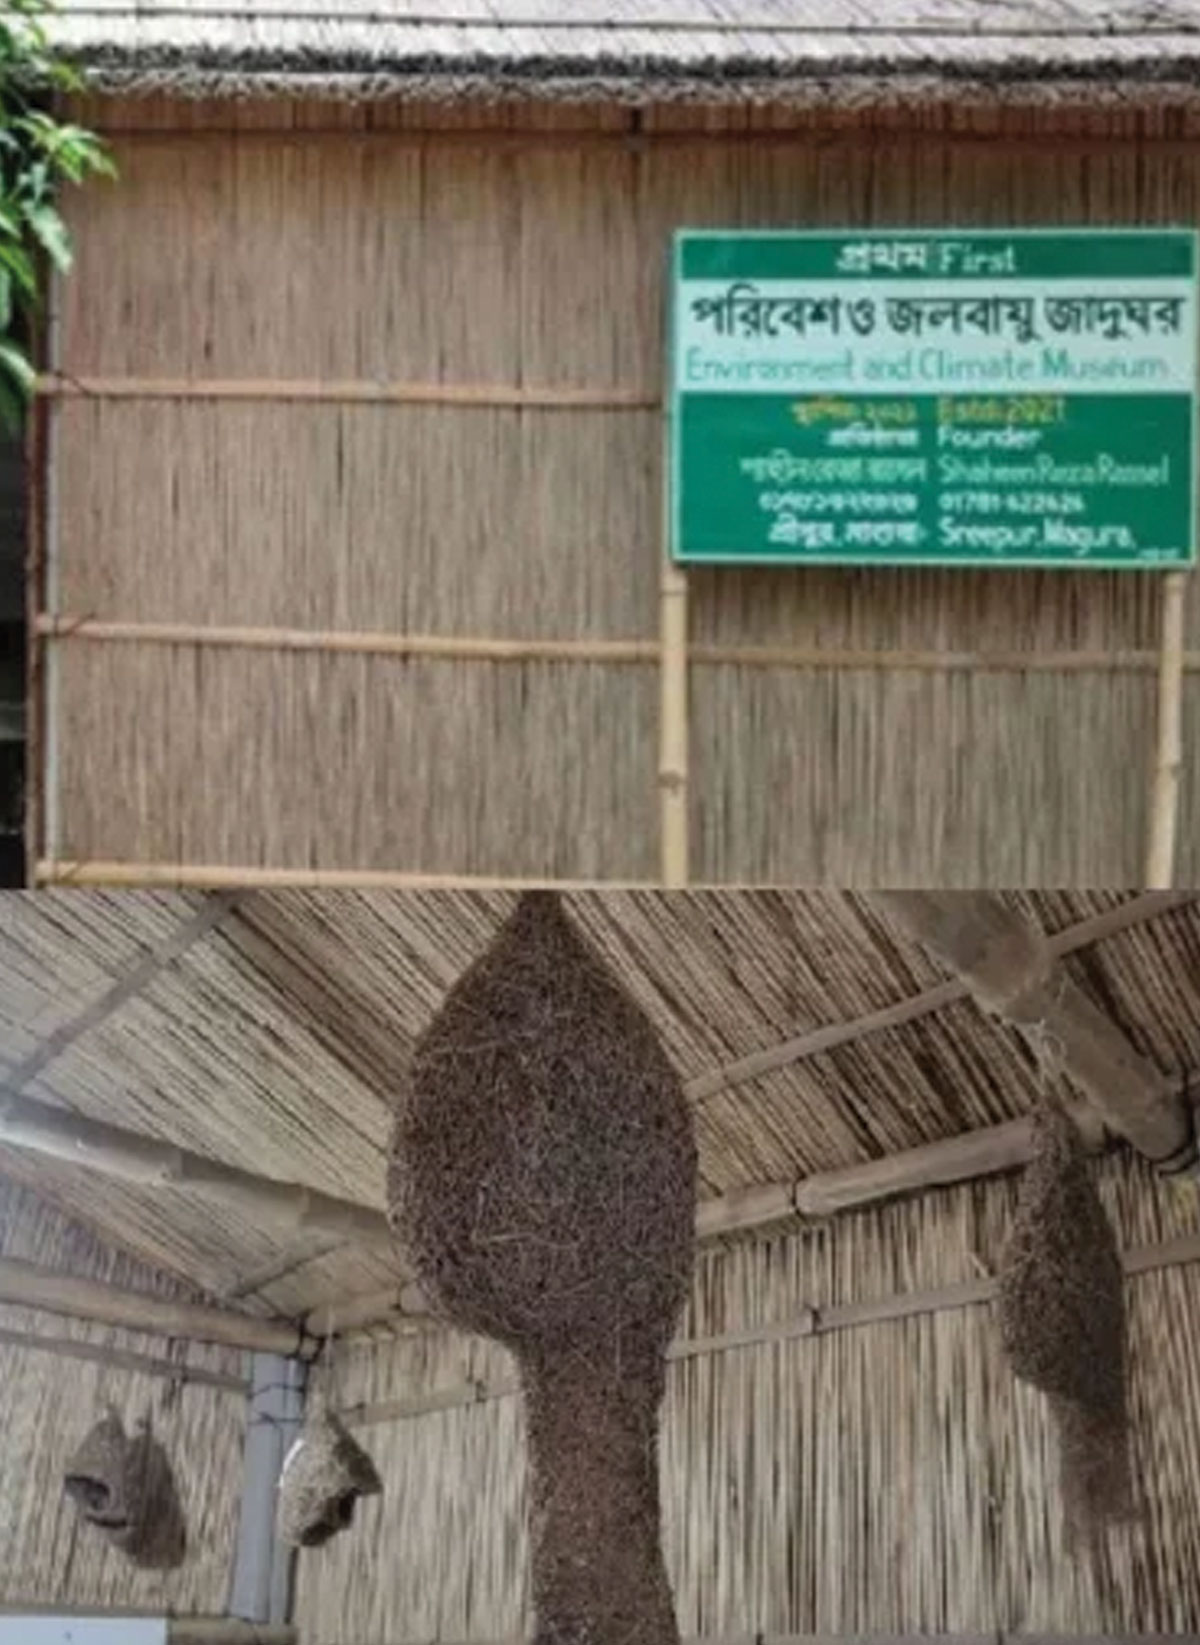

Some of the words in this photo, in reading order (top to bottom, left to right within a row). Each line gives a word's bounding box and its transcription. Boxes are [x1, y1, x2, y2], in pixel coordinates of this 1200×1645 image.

[938, 243, 1018, 273] First
[692, 283, 841, 338] পরিবেশ
[846, 297, 877, 337] ও
[1044, 296, 1186, 343] জাদুঘর
[686, 347, 853, 382] Environment
[863, 350, 913, 381] and
[918, 348, 1037, 381] Climate
[1042, 349, 1171, 379] Museum
[937, 426, 1043, 448] Founder
